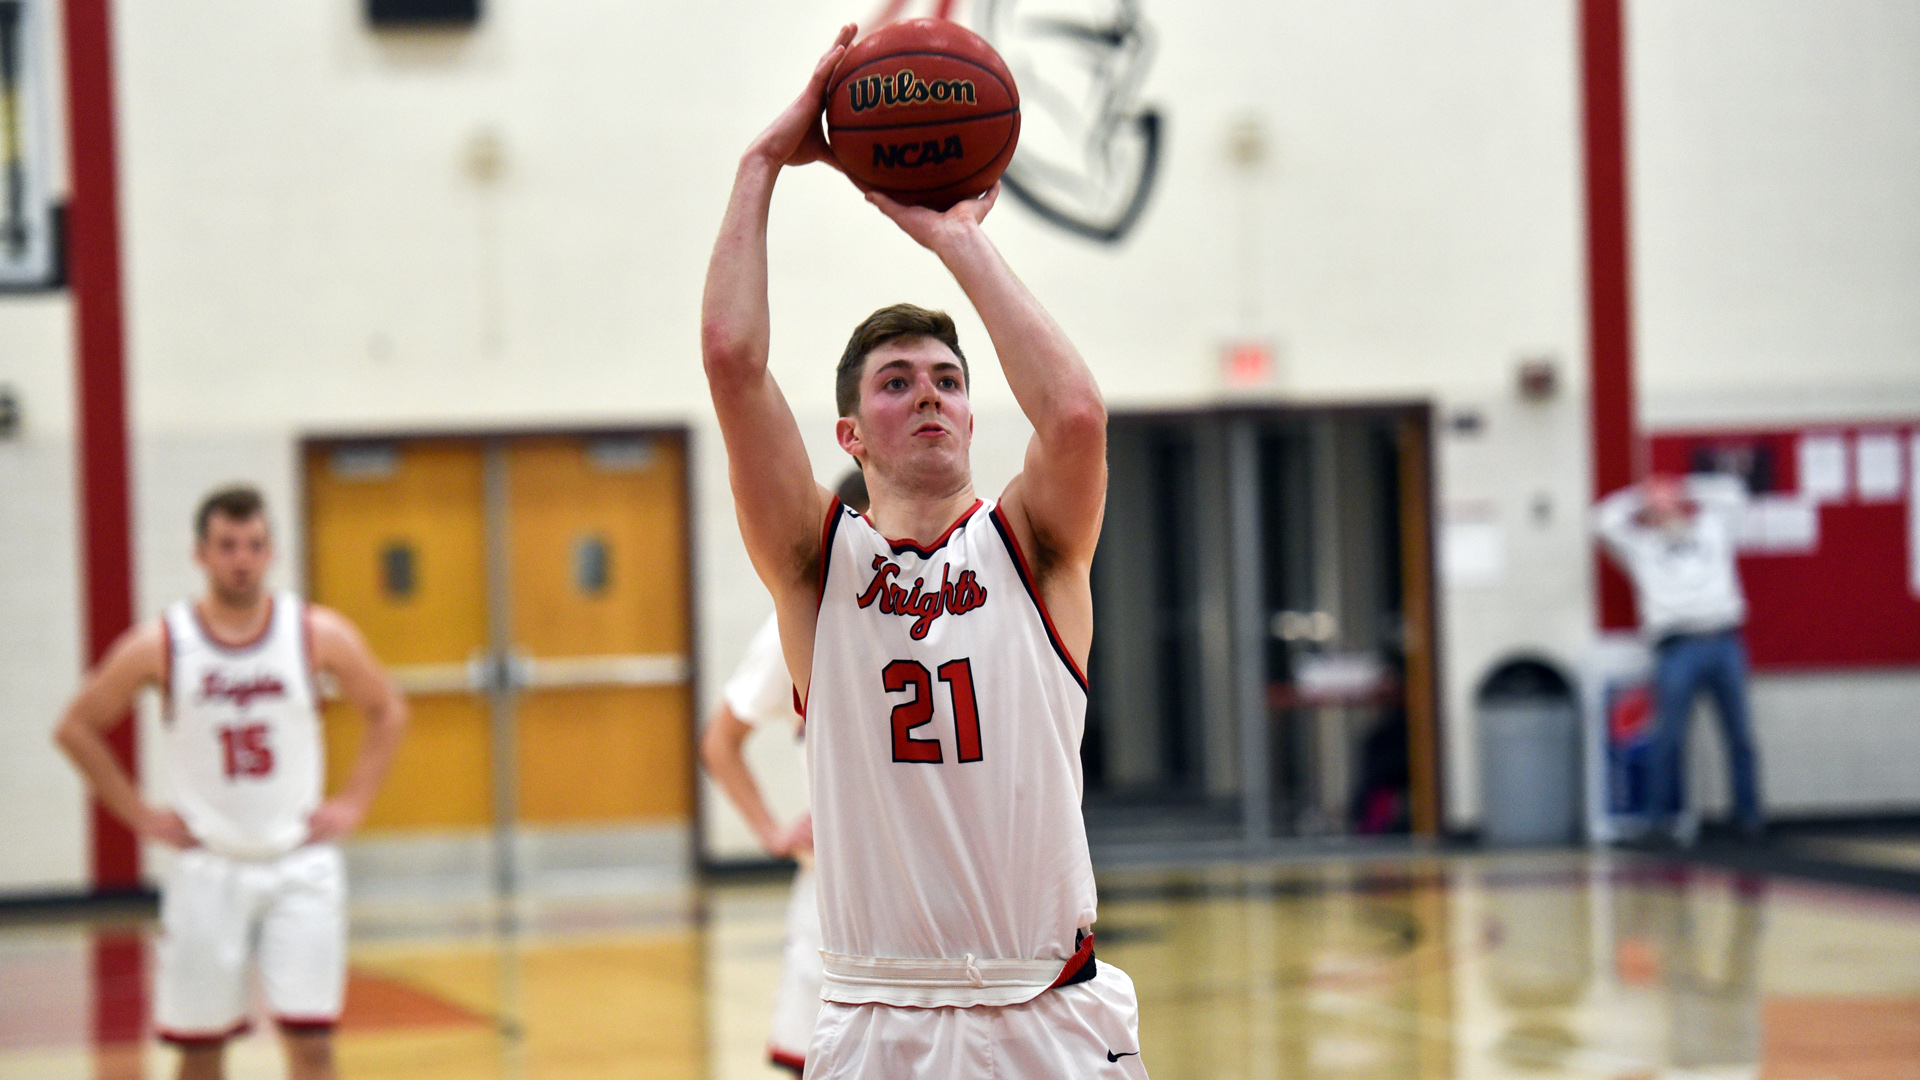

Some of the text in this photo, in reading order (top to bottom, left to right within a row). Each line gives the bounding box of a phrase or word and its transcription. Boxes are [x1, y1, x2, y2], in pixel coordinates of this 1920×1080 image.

[848, 69, 977, 112] Wilson
[872, 134, 964, 168] NCAA
[856, 554, 987, 640] Knights
[882, 657, 983, 764] 21
[219, 724, 275, 779] 15
